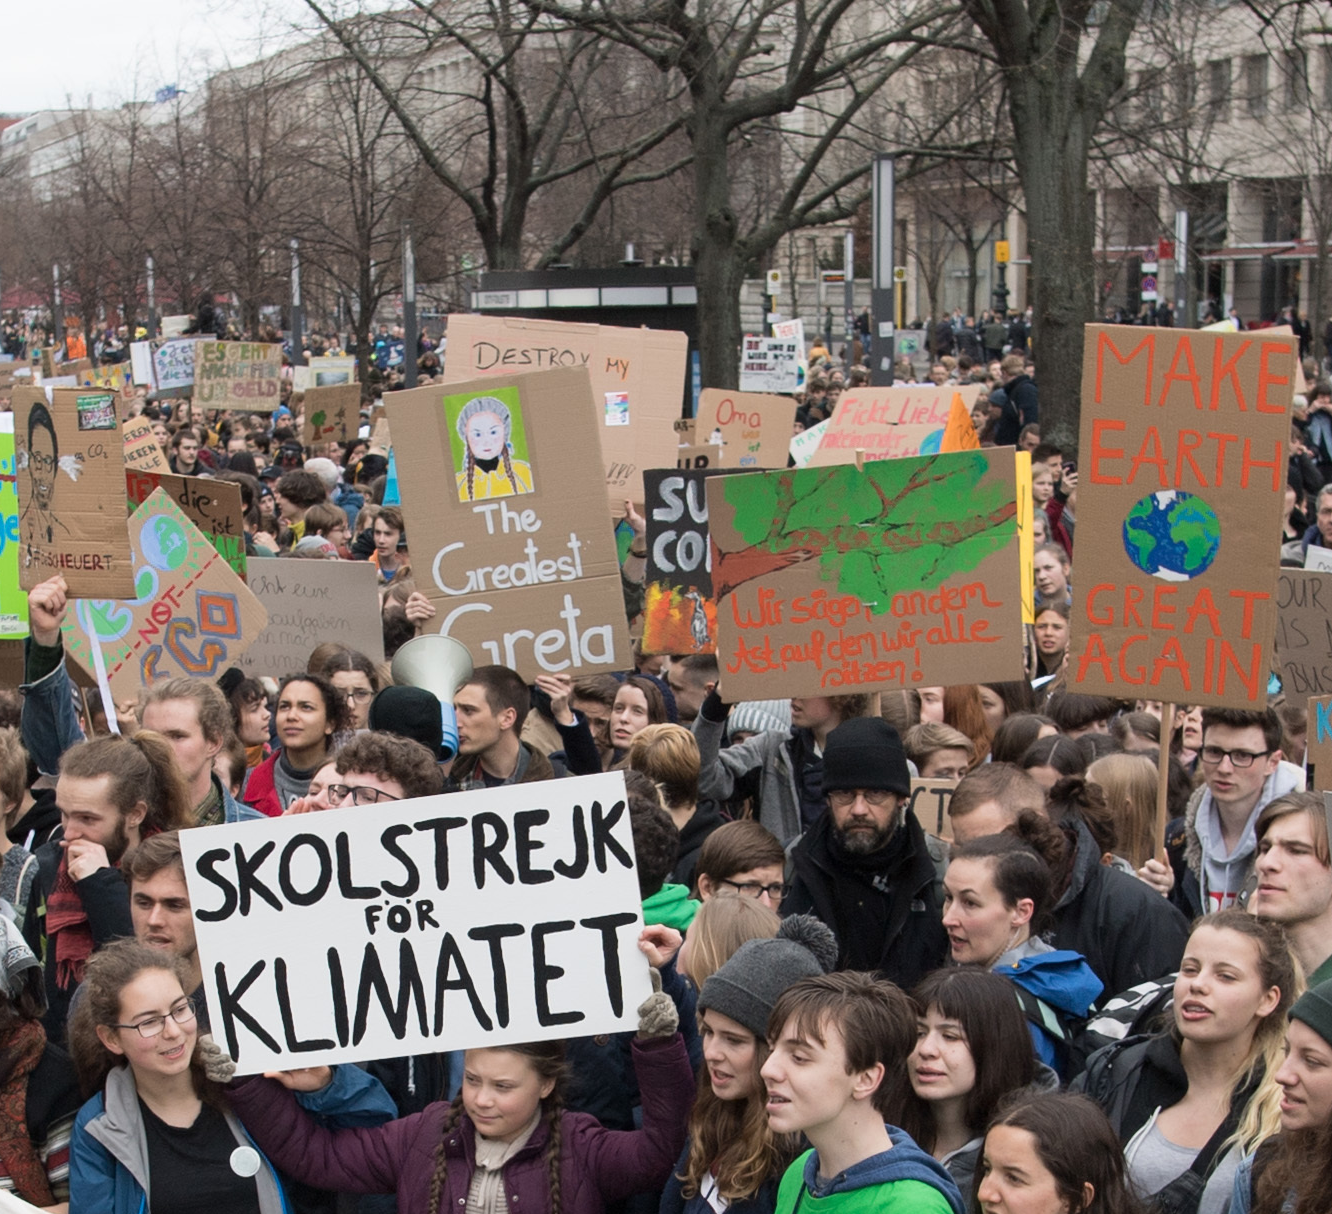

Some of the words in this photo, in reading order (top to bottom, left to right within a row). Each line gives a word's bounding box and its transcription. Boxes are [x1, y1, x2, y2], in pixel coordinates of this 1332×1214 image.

[606, 357, 630, 381] MY
[1095, 332, 1291, 413] MAKE
[717, 399, 761, 428] Oma
[1089, 418, 1283, 492] EARTH
[179, 479, 210, 517] die
[472, 501, 542, 535] The
[212, 516, 234, 535] ist
[432, 532, 584, 596] Greatest
[731, 587, 783, 629] Wir
[1086, 583, 1271, 639] GREAT
[1278, 576, 1327, 612] OUR
[780, 630, 824, 669] auf
[882, 621, 923, 652] wir
[926, 613, 1004, 645] alle
[1280, 617, 1309, 647] IS
[1076, 634, 1263, 701] AGAIN
[195, 800, 634, 922] SKOLSTREJK
[365, 898, 440, 935] FÖR
[214, 912, 638, 1063] KLIMATET
